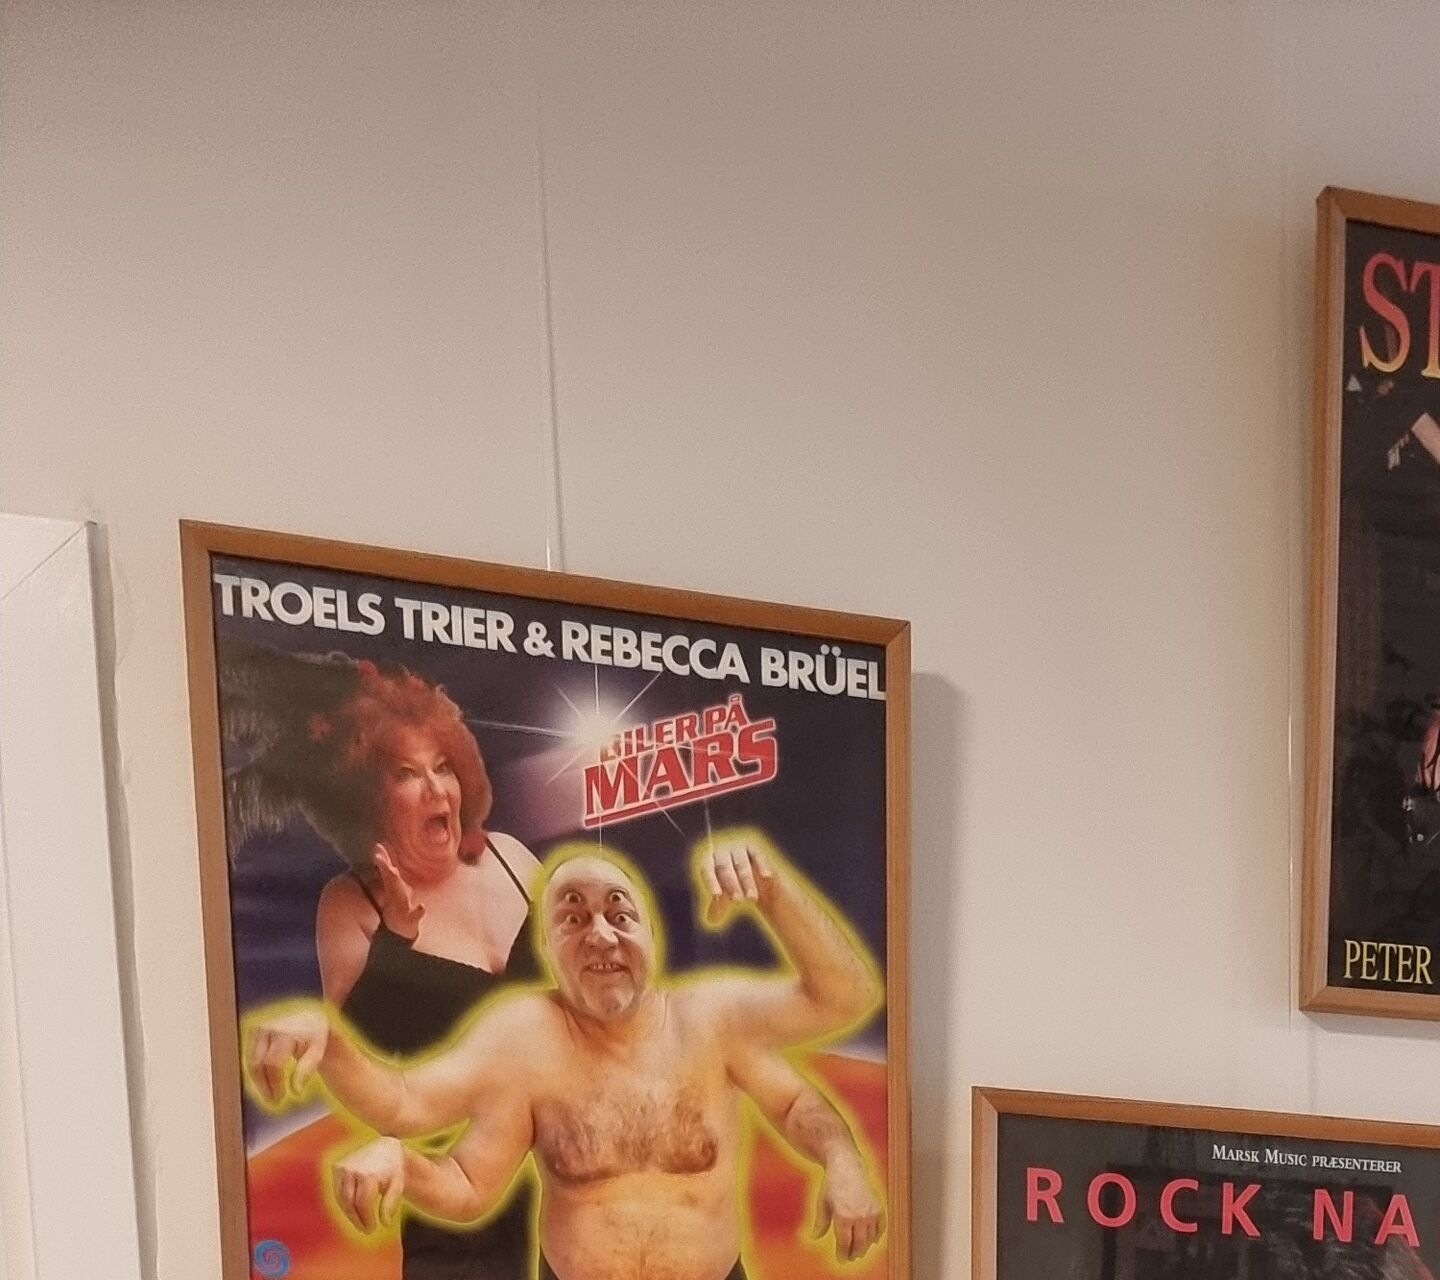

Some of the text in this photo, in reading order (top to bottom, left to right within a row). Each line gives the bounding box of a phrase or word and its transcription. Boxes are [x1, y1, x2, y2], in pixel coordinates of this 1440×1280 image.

[214, 573, 888, 701] TROELS TRIER & REBECCA BRÜEL
[704, 694, 750, 735] PÅ
[584, 718, 776, 818] MARS
[1343, 939, 1433, 985] PETER
[1025, 1167, 1262, 1238] ROCK
